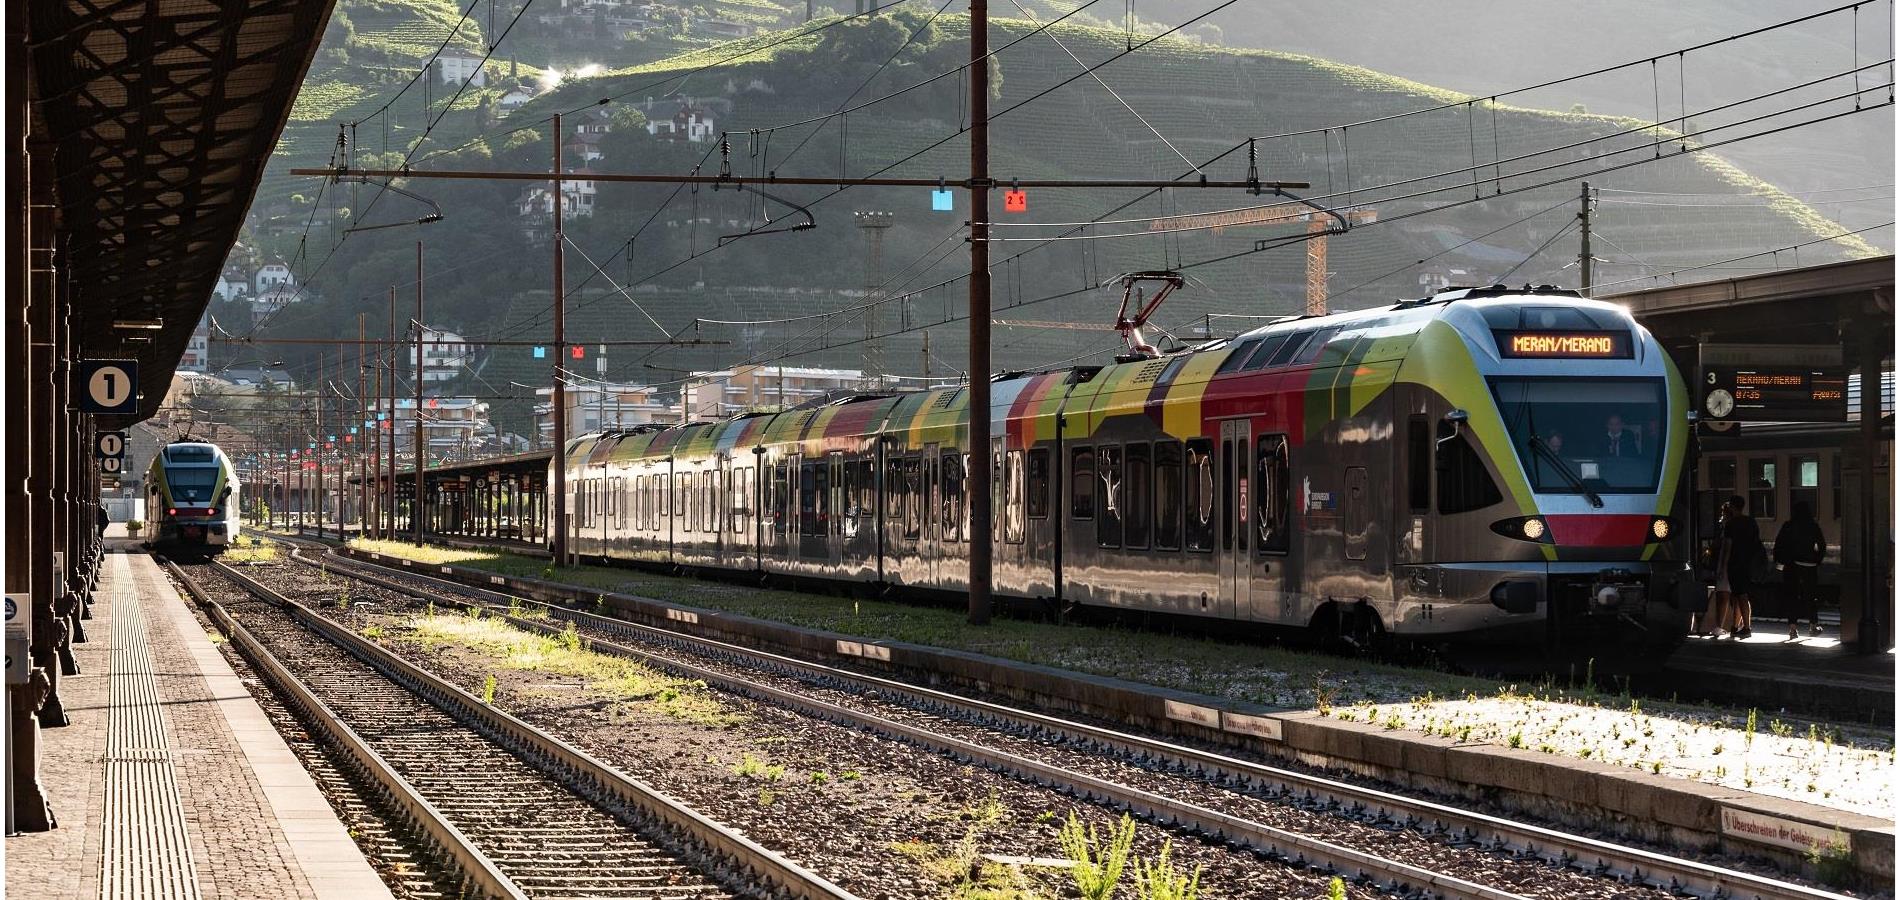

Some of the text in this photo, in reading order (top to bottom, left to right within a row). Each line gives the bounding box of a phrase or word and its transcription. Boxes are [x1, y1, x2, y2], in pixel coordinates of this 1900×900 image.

[1513, 336, 1611, 353] MERAN/MERANO
[1707, 372, 1716, 384] 3
[104, 374, 115, 399] 1
[108, 439, 114, 451] 1
[109, 460, 113, 469] 1
[1732, 811, 1777, 838] Überschreiten
[1779, 826, 1790, 840] der
[1790, 828, 1814, 847] Geleise
